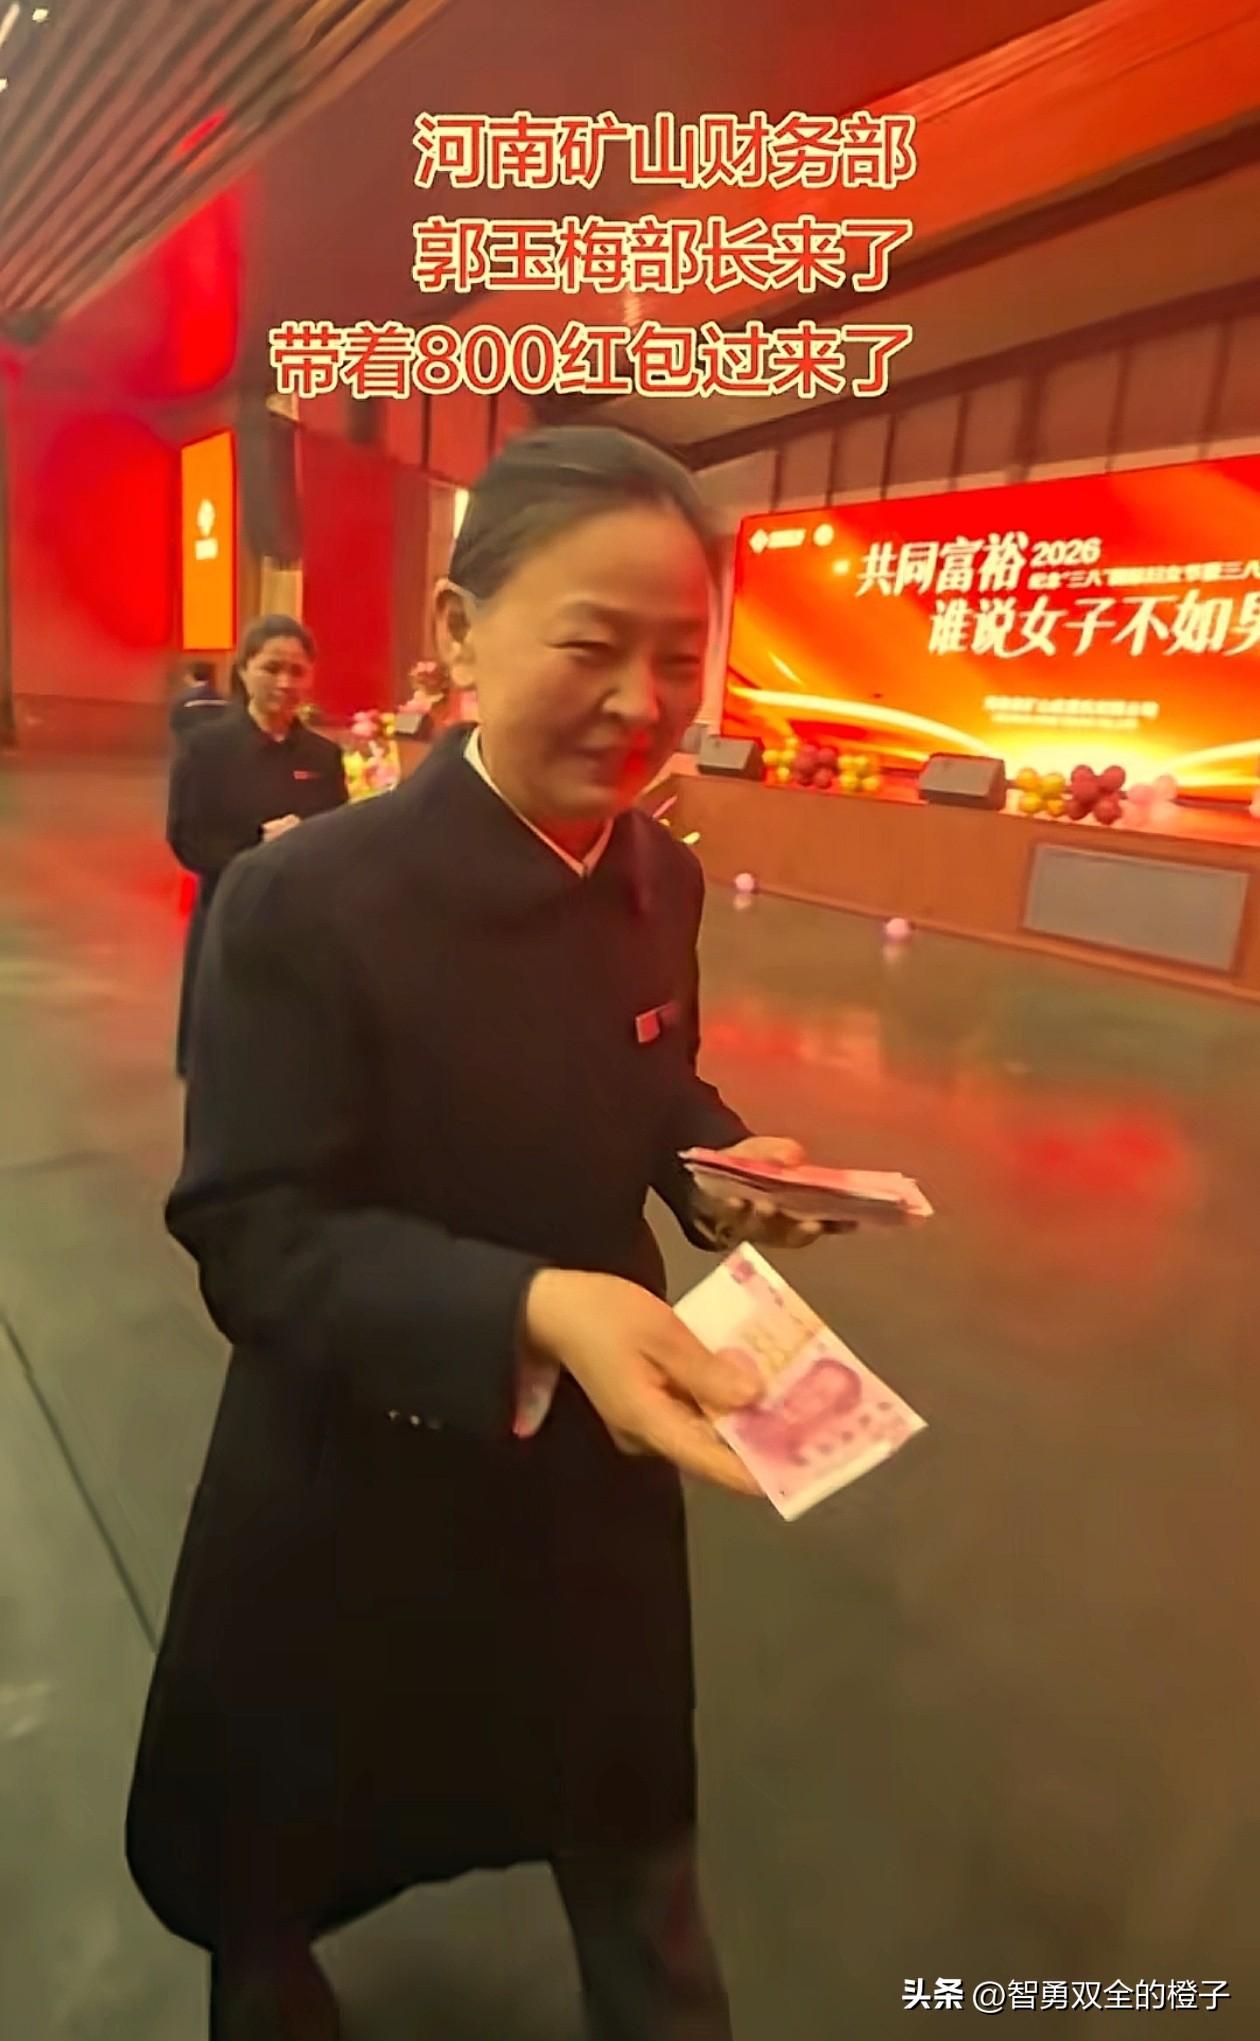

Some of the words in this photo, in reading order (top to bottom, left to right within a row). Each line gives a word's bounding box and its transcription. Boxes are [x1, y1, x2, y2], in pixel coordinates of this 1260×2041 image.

[855, 531, 1029, 597] 共同富裕
[1030, 537, 1102, 567] 2026
